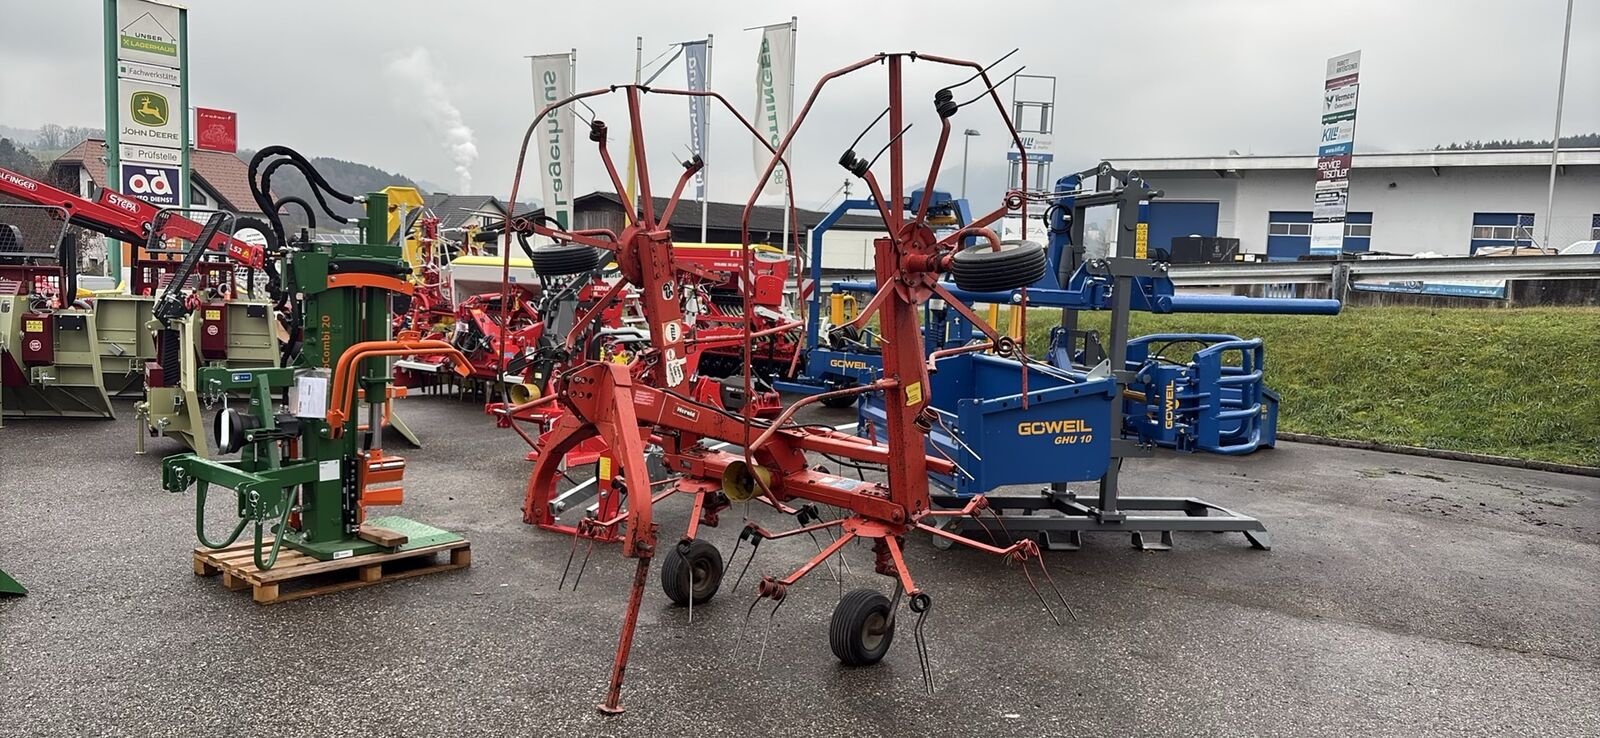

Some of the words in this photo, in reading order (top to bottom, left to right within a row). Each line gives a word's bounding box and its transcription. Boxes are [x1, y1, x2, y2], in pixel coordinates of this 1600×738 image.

[134, 32, 163, 42] UNSER
[130, 40, 175, 53] LAGERHAUS
[129, 68, 177, 81] Fachwerkstätte
[122, 127, 148, 137] JOHN
[149, 129, 179, 140] DEERE
[138, 150, 178, 162] Prüfstelle
[108, 194, 138, 213] STEPA
[321, 315, 331, 328] 20
[1054, 435, 1078, 445] GHU
[1080, 434, 1093, 444] 10
